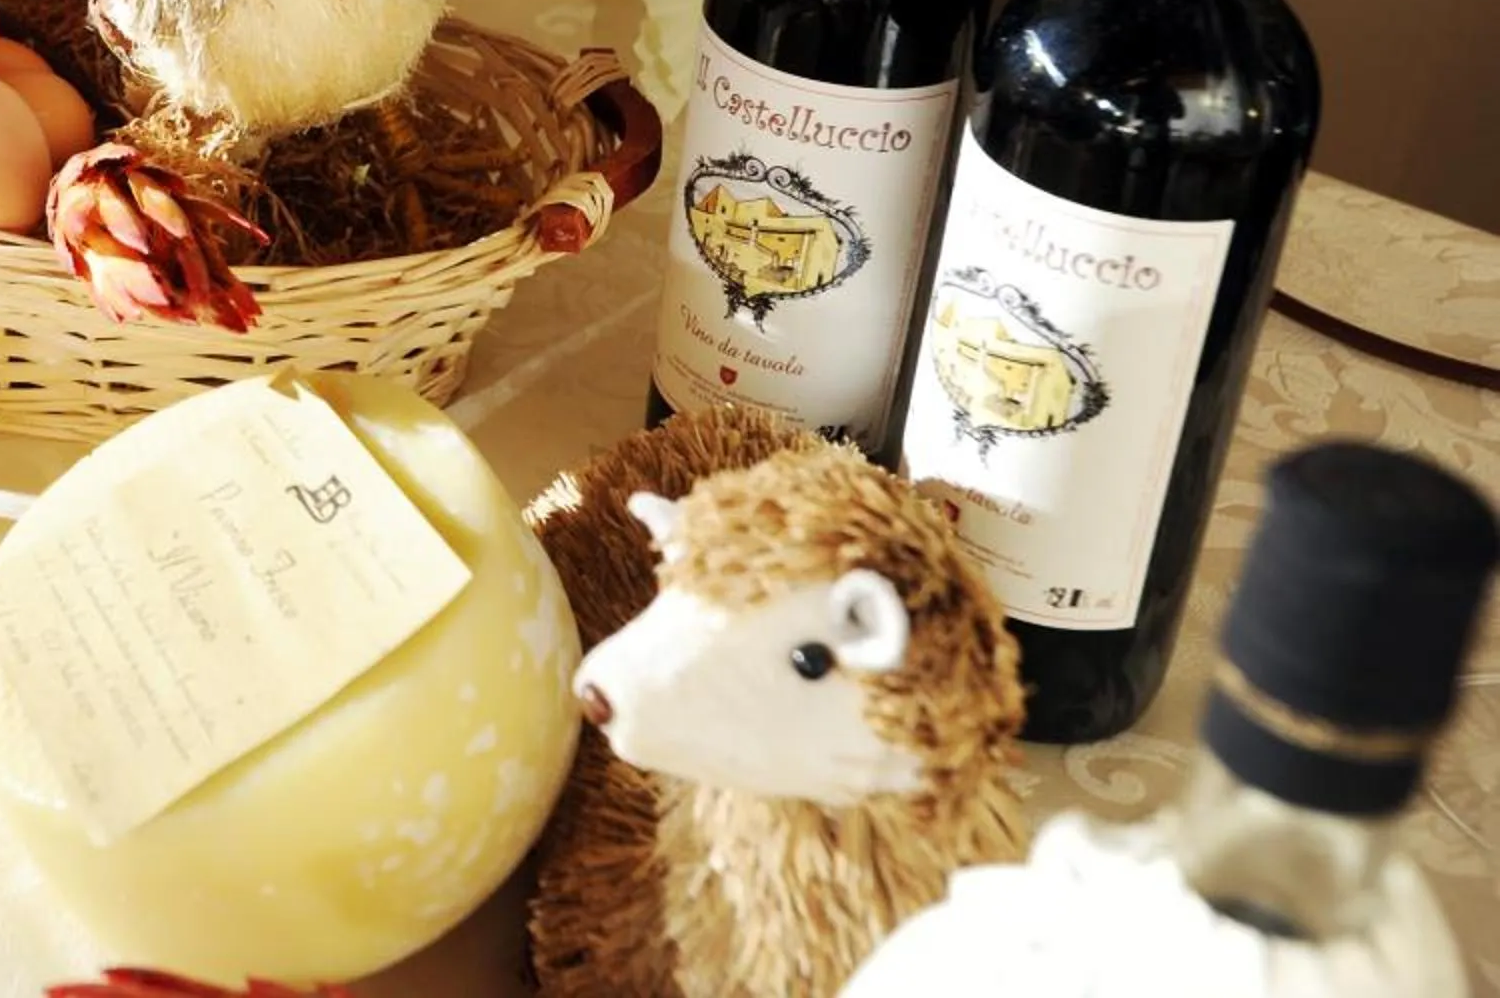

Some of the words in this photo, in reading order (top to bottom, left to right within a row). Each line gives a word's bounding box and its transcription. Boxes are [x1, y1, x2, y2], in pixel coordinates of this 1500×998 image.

[713, 75, 912, 152] Castelluccio
[680, 304, 714, 346] Vino
[717, 337, 739, 360] da
[743, 349, 805, 377] tavola
